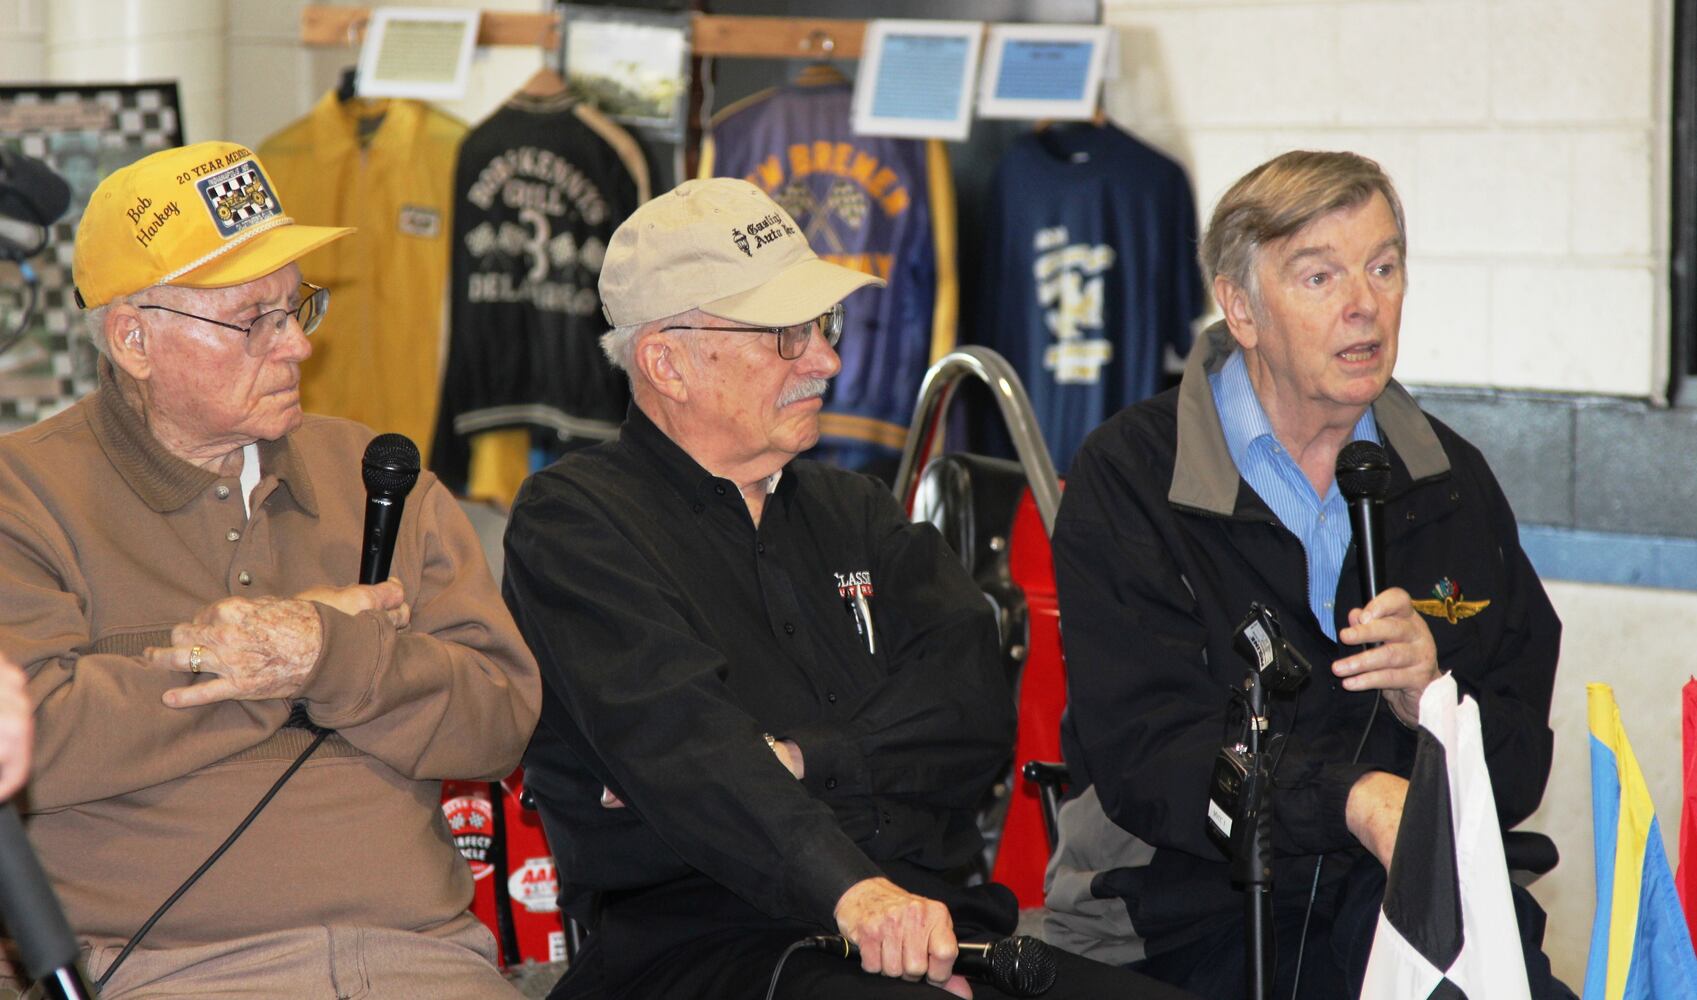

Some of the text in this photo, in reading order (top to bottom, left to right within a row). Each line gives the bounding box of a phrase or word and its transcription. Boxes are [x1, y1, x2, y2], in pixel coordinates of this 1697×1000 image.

[176, 172, 191, 185] 20
[191, 158, 225, 177] YEAR
[126, 196, 152, 225] Bob
[136, 201, 181, 248] Harkey
[519, 208, 550, 284] 3
[754, 229, 782, 249] Auto
